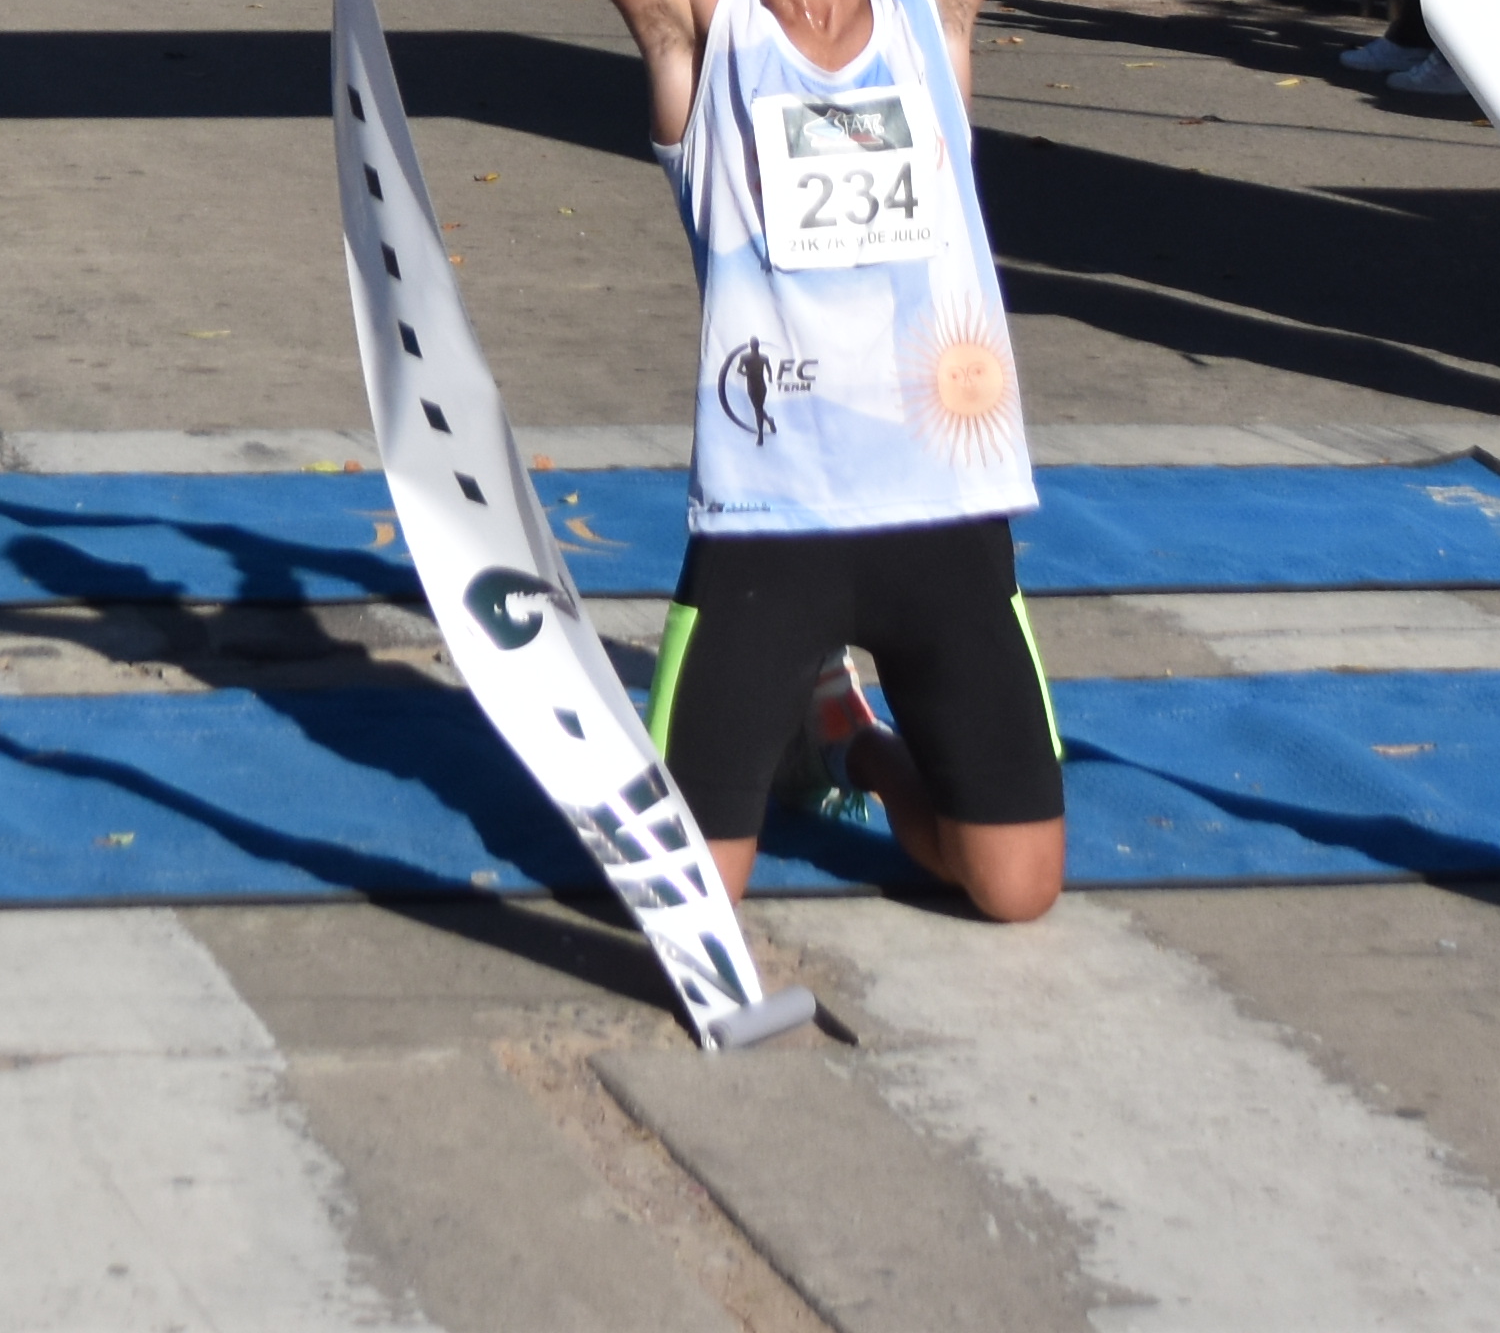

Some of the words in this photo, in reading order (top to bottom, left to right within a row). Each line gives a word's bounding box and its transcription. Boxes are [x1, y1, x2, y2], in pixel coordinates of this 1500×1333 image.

[796, 161, 919, 229] 234
[868, 229, 886, 244] DE
[891, 227, 931, 243] JULIO
[777, 359, 819, 381] FC
